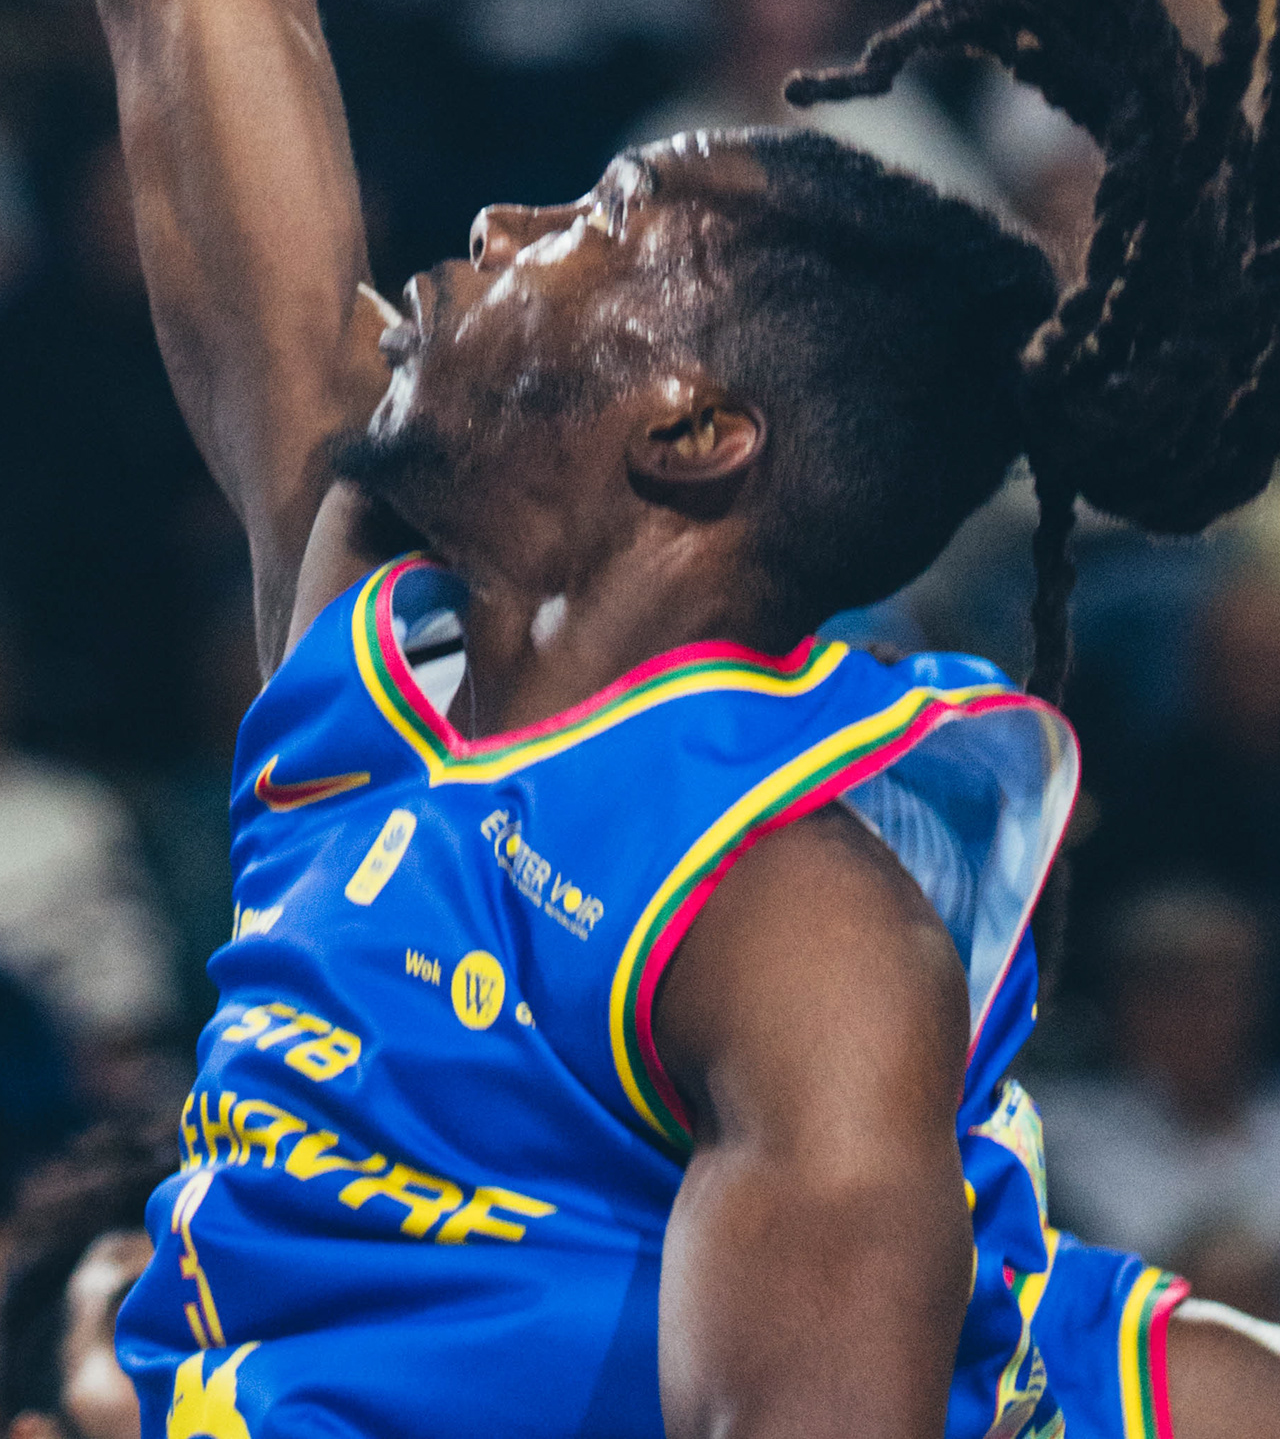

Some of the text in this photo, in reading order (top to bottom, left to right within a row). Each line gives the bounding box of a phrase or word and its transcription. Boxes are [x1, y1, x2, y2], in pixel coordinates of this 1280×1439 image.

[550, 871, 604, 931] VOIR
[405, 947, 442, 987] Wok
[221, 1002, 362, 1082] STB
